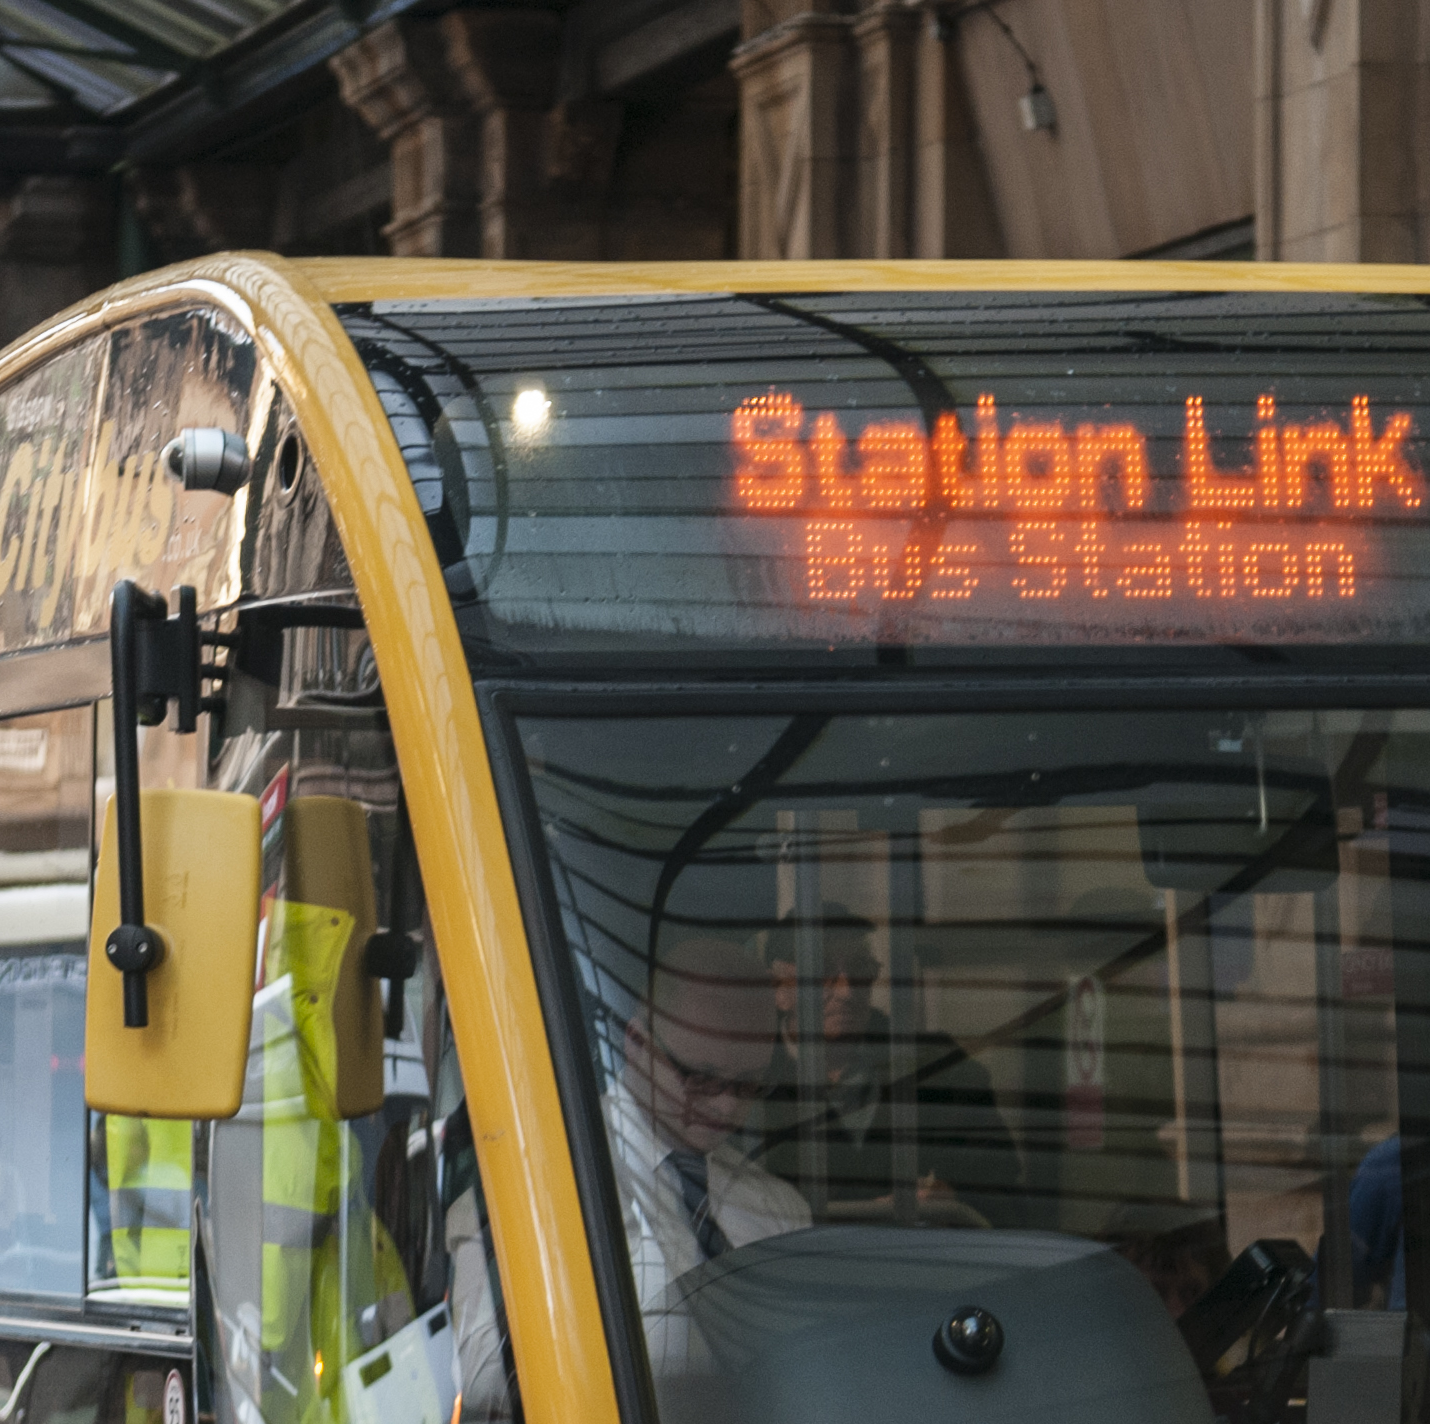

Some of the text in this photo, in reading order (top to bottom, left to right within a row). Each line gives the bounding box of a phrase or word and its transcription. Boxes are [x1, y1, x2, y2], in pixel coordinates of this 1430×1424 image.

[733, 391, 1421, 508] Station Link
[806, 521, 1357, 599] Bus Station
